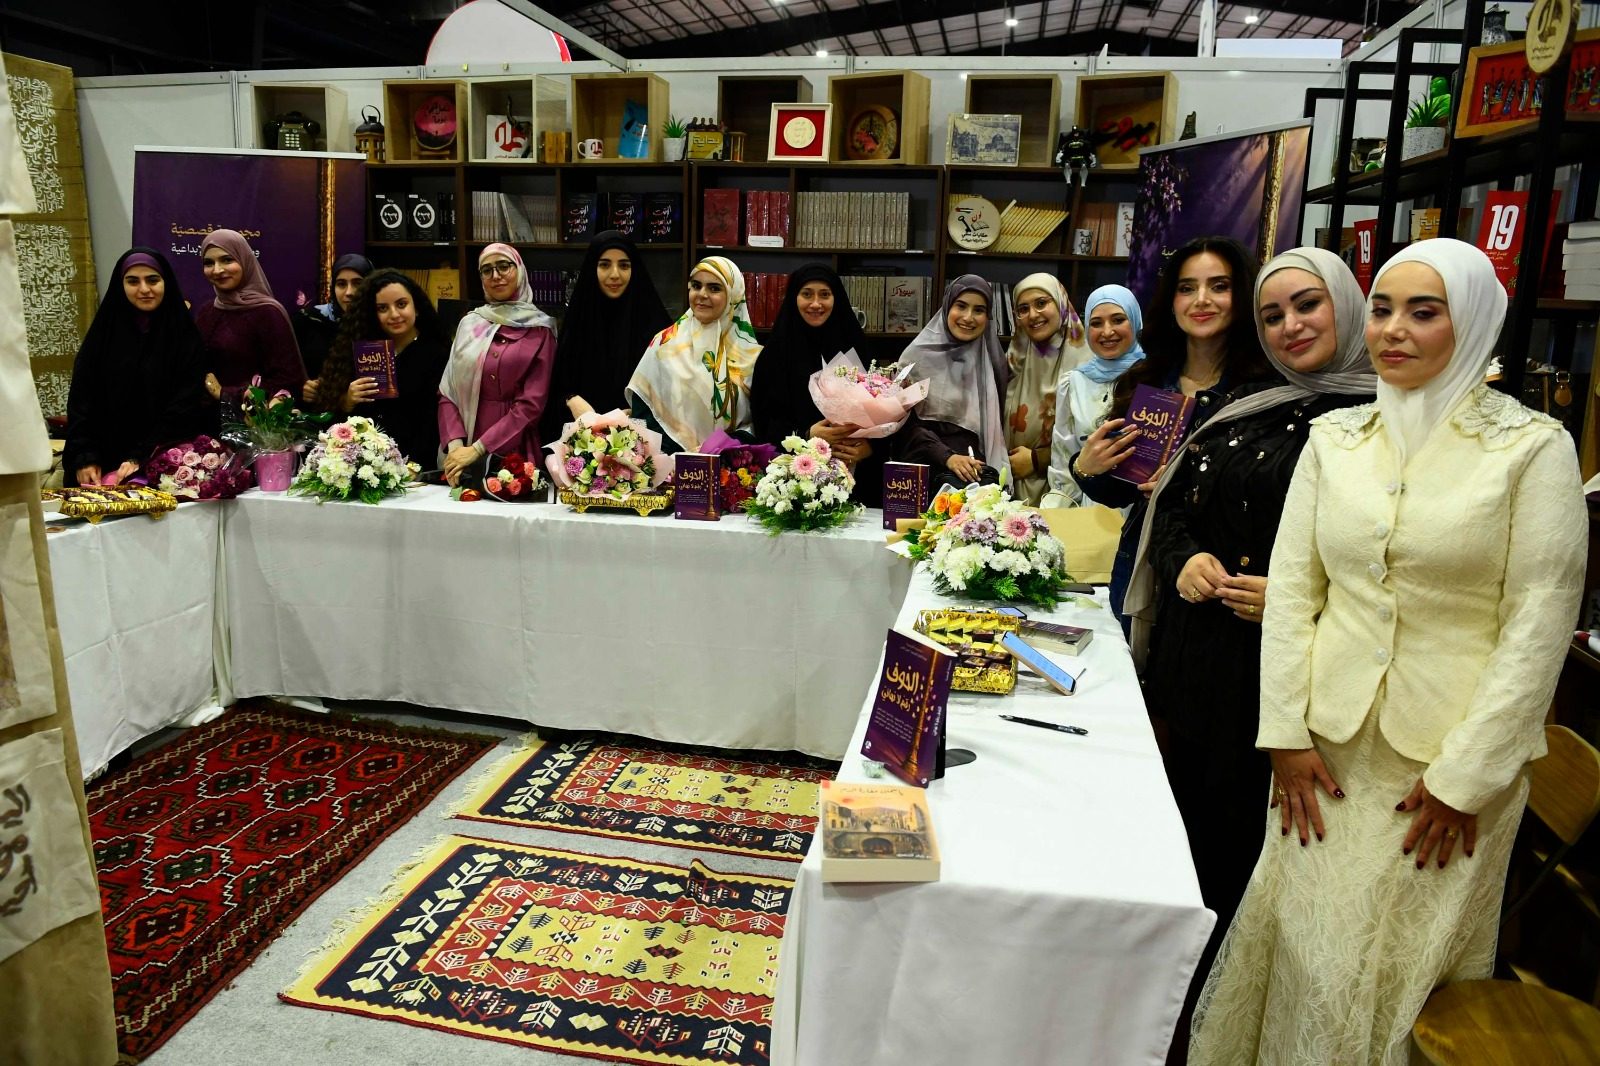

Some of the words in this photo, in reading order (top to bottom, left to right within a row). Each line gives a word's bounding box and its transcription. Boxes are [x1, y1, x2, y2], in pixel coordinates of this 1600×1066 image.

[1486, 204, 1520, 251] 19
[1358, 230, 1371, 264] 19
[357, 351, 382, 365] الخوف
[1132, 406, 1170, 428] الخوف
[678, 468, 704, 482] الخوف
[886, 477, 913, 492] الخوف
[886, 661, 920, 695] الخوف
